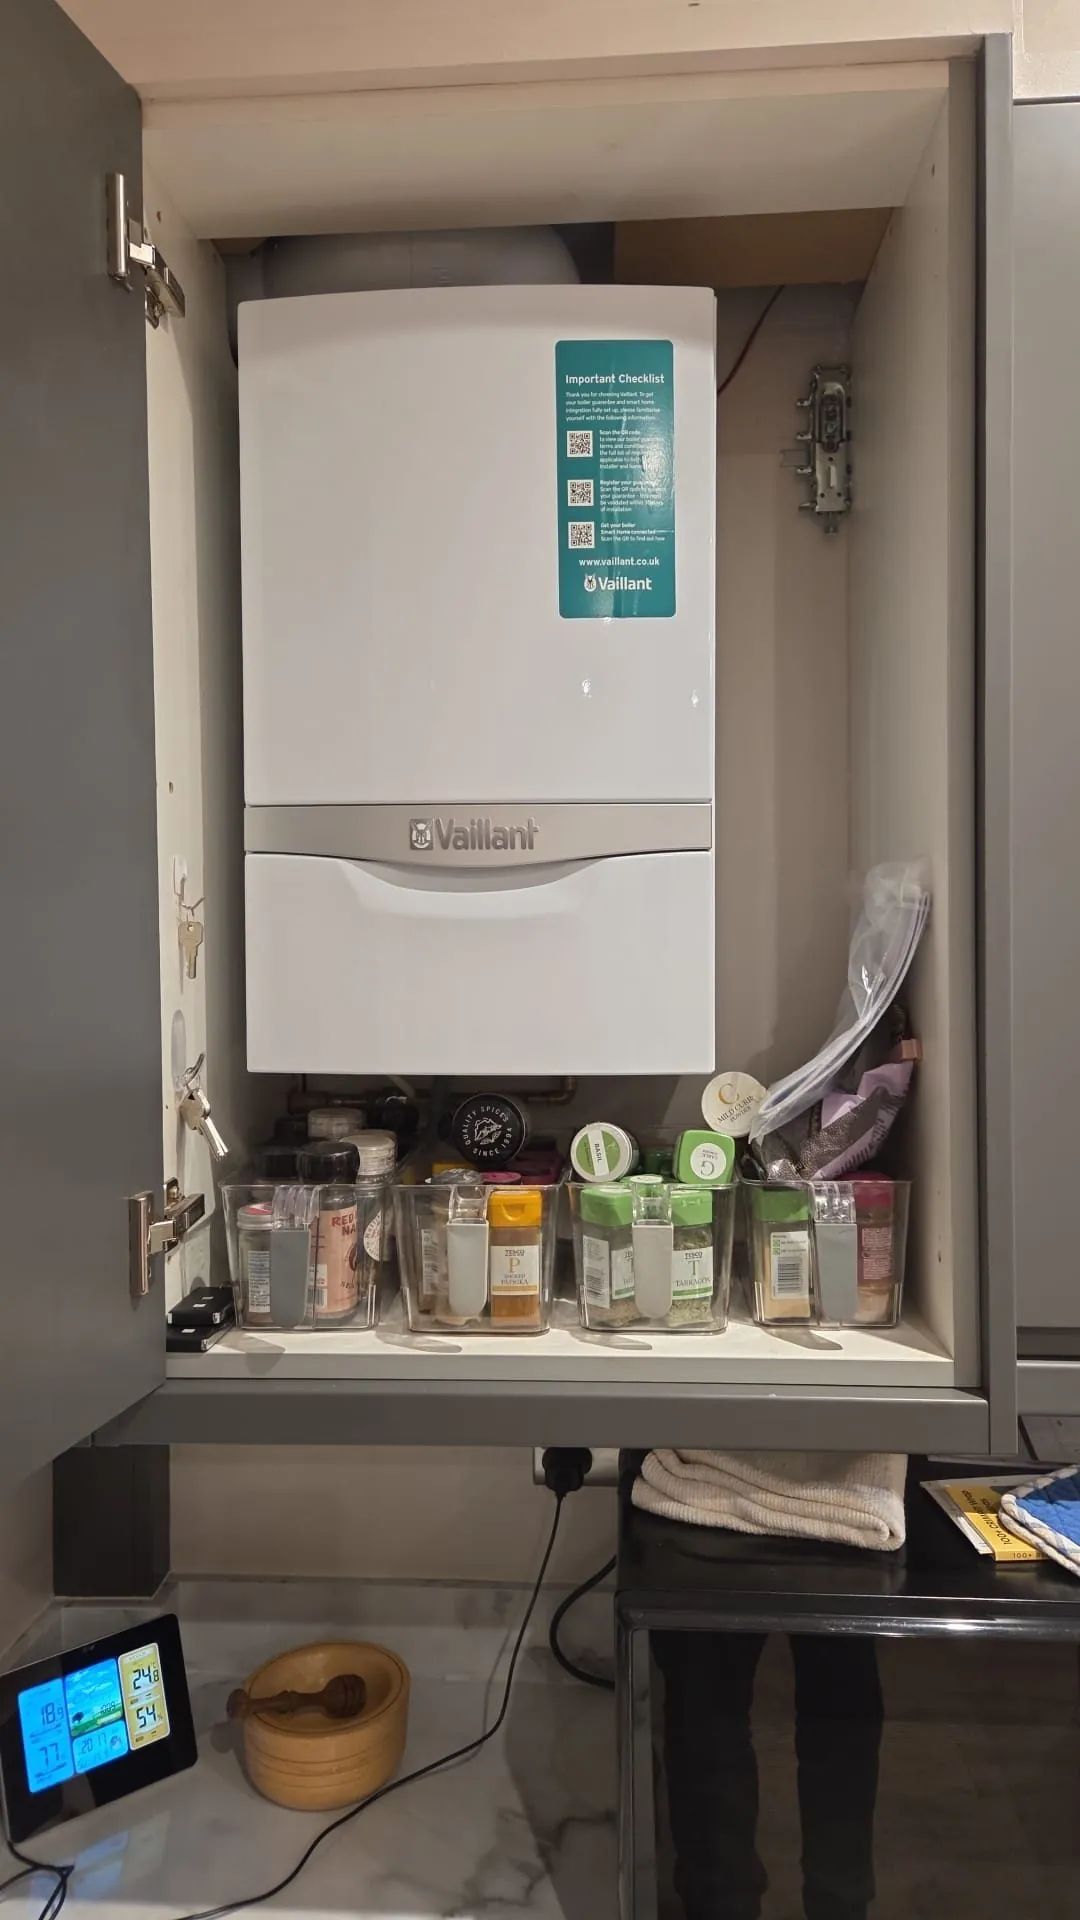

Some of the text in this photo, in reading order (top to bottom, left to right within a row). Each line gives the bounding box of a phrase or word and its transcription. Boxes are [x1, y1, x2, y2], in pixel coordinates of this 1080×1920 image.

[565, 373, 664, 386] Important Checklist
[579, 557, 660, 566] www.vaillant.co.uk
[598, 577, 652, 590] Vaillant
[434, 817, 539, 850] Vaillant
[718, 1083, 740, 1104] C
[717, 1095, 754, 1122] MILD CURR
[462, 1106, 509, 1145] QUALITY SPICES
[472, 1147, 500, 1157] SINCE
[594, 1143, 602, 1164] BASIL
[701, 1160, 714, 1176] G
[685, 1251, 703, 1259] TESCO
[509, 1257, 521, 1273] P
[688, 1260, 700, 1275] T
[676, 1278, 711, 1287] TARRAGON
[996, 1530, 1012, 1545] 100+
[136, 1704, 158, 1729] 54
[40, 1743, 60, 1766] 77
